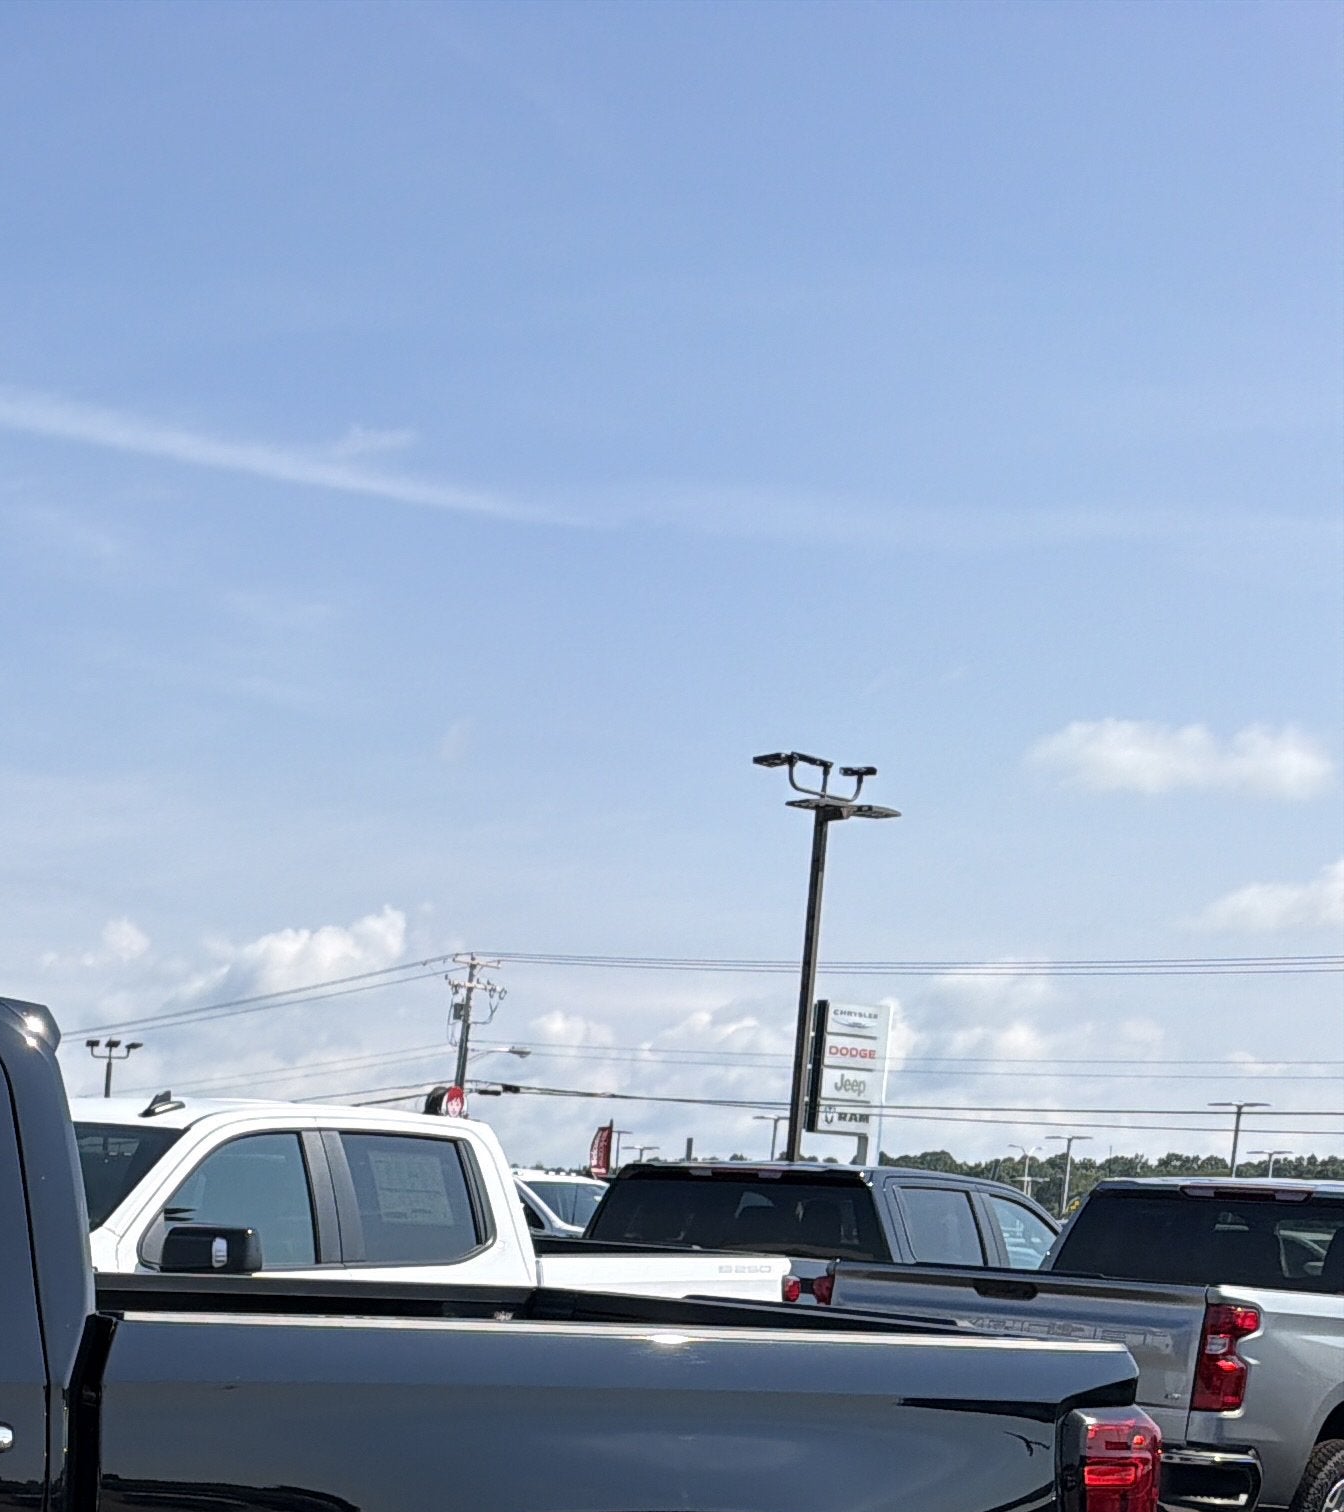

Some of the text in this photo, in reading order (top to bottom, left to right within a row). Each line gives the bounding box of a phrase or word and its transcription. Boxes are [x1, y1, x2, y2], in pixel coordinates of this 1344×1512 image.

[833, 1008, 879, 1020] CHRYSLER
[828, 1045, 877, 1060] DODGE
[834, 1073, 867, 1097] Jeep
[837, 1111, 871, 1125] RAM
